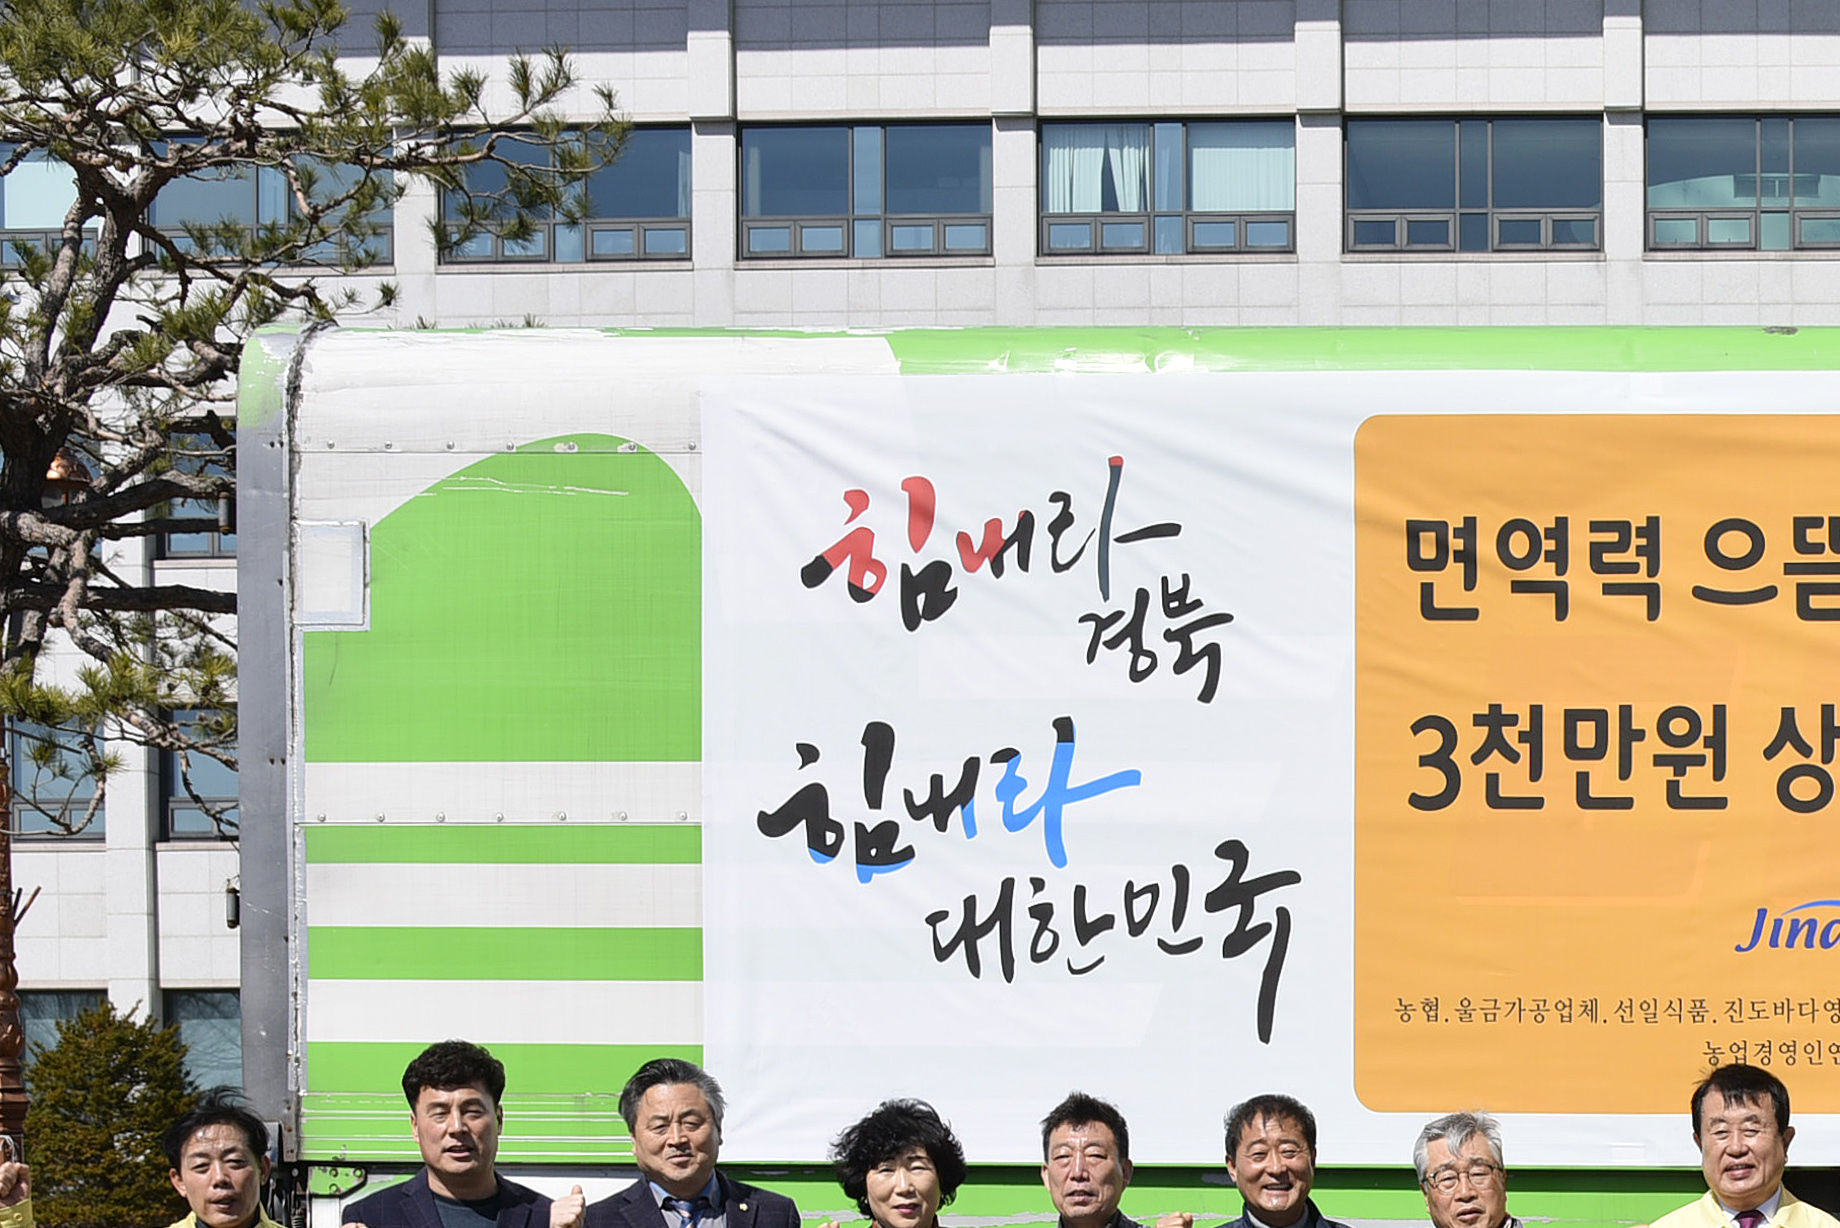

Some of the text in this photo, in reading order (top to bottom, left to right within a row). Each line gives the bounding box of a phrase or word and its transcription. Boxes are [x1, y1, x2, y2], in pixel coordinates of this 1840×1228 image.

[800, 455, 1182, 632] 힘내라
[1405, 515, 1661, 622] 면역력
[1077, 572, 1234, 704] 경북
[756, 715, 1143, 885] 힘내라
[1407, 703, 1728, 812] 3천만원
[924, 839, 1302, 1045] 대한민국
